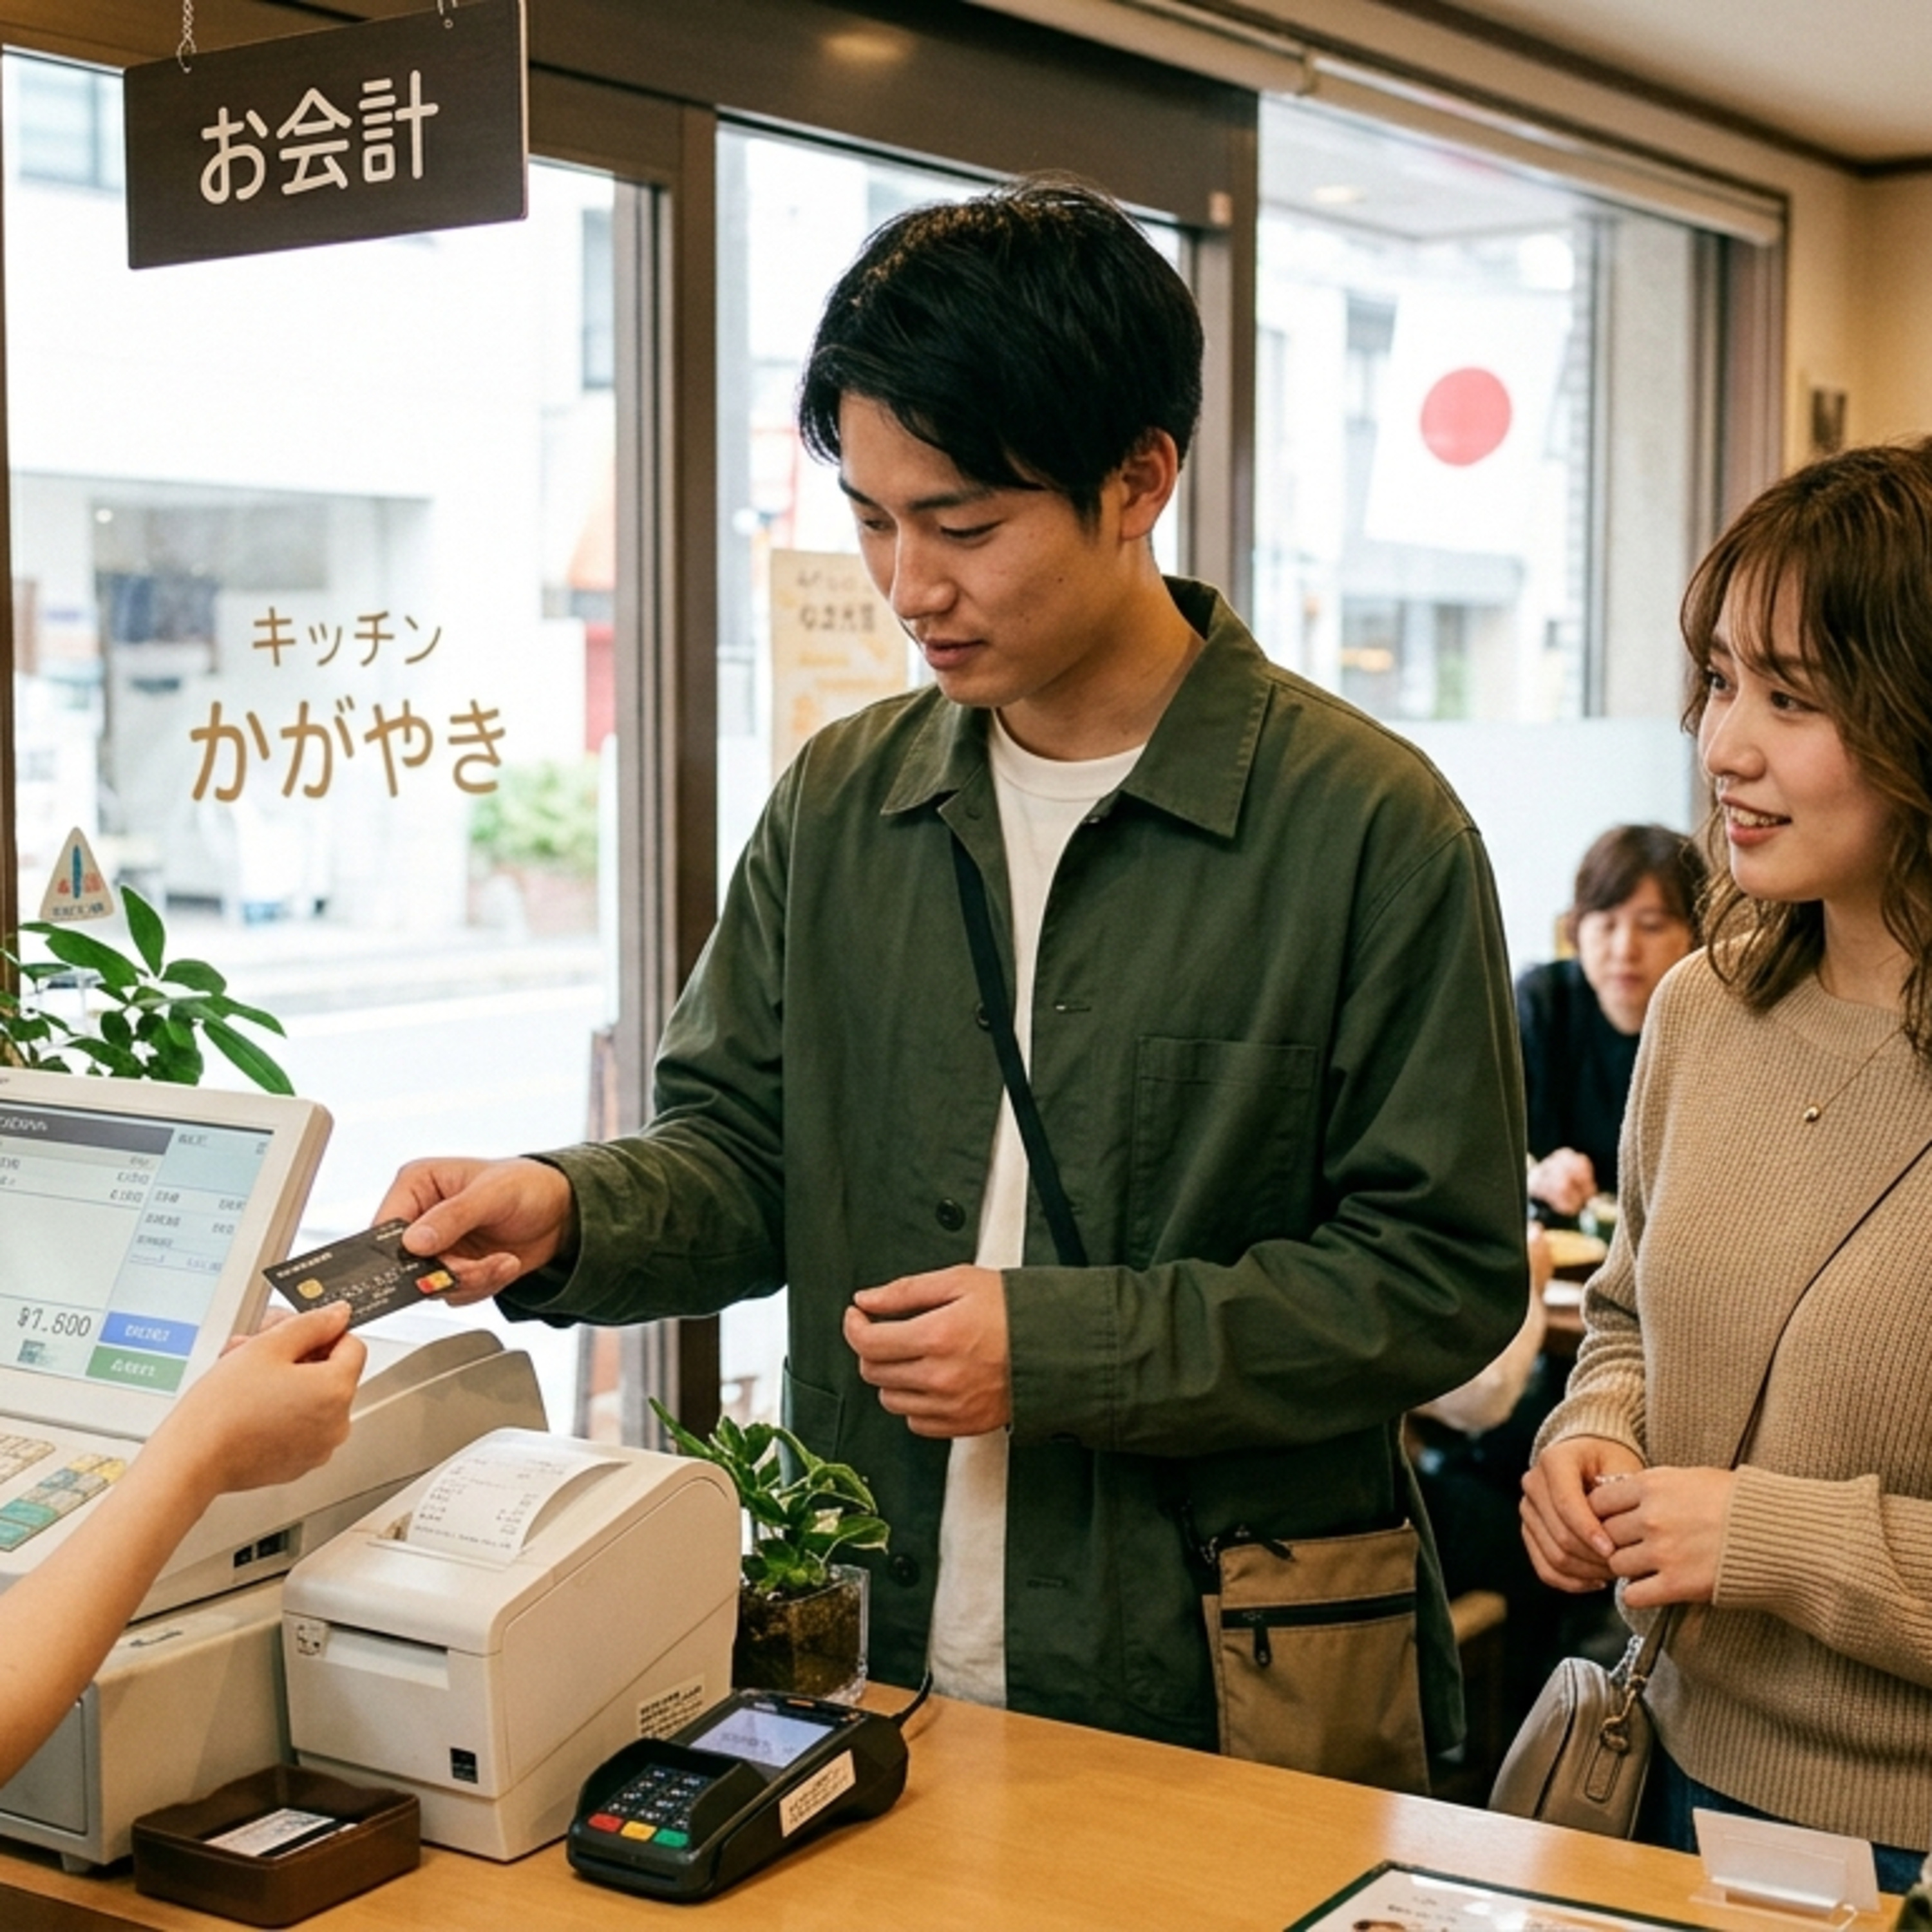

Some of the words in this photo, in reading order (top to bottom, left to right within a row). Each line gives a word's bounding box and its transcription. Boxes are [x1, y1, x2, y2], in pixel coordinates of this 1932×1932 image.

[201, 70, 439, 204] お会計
[252, 606, 442, 667] キッチン
[190, 695, 506, 802] かがやき
